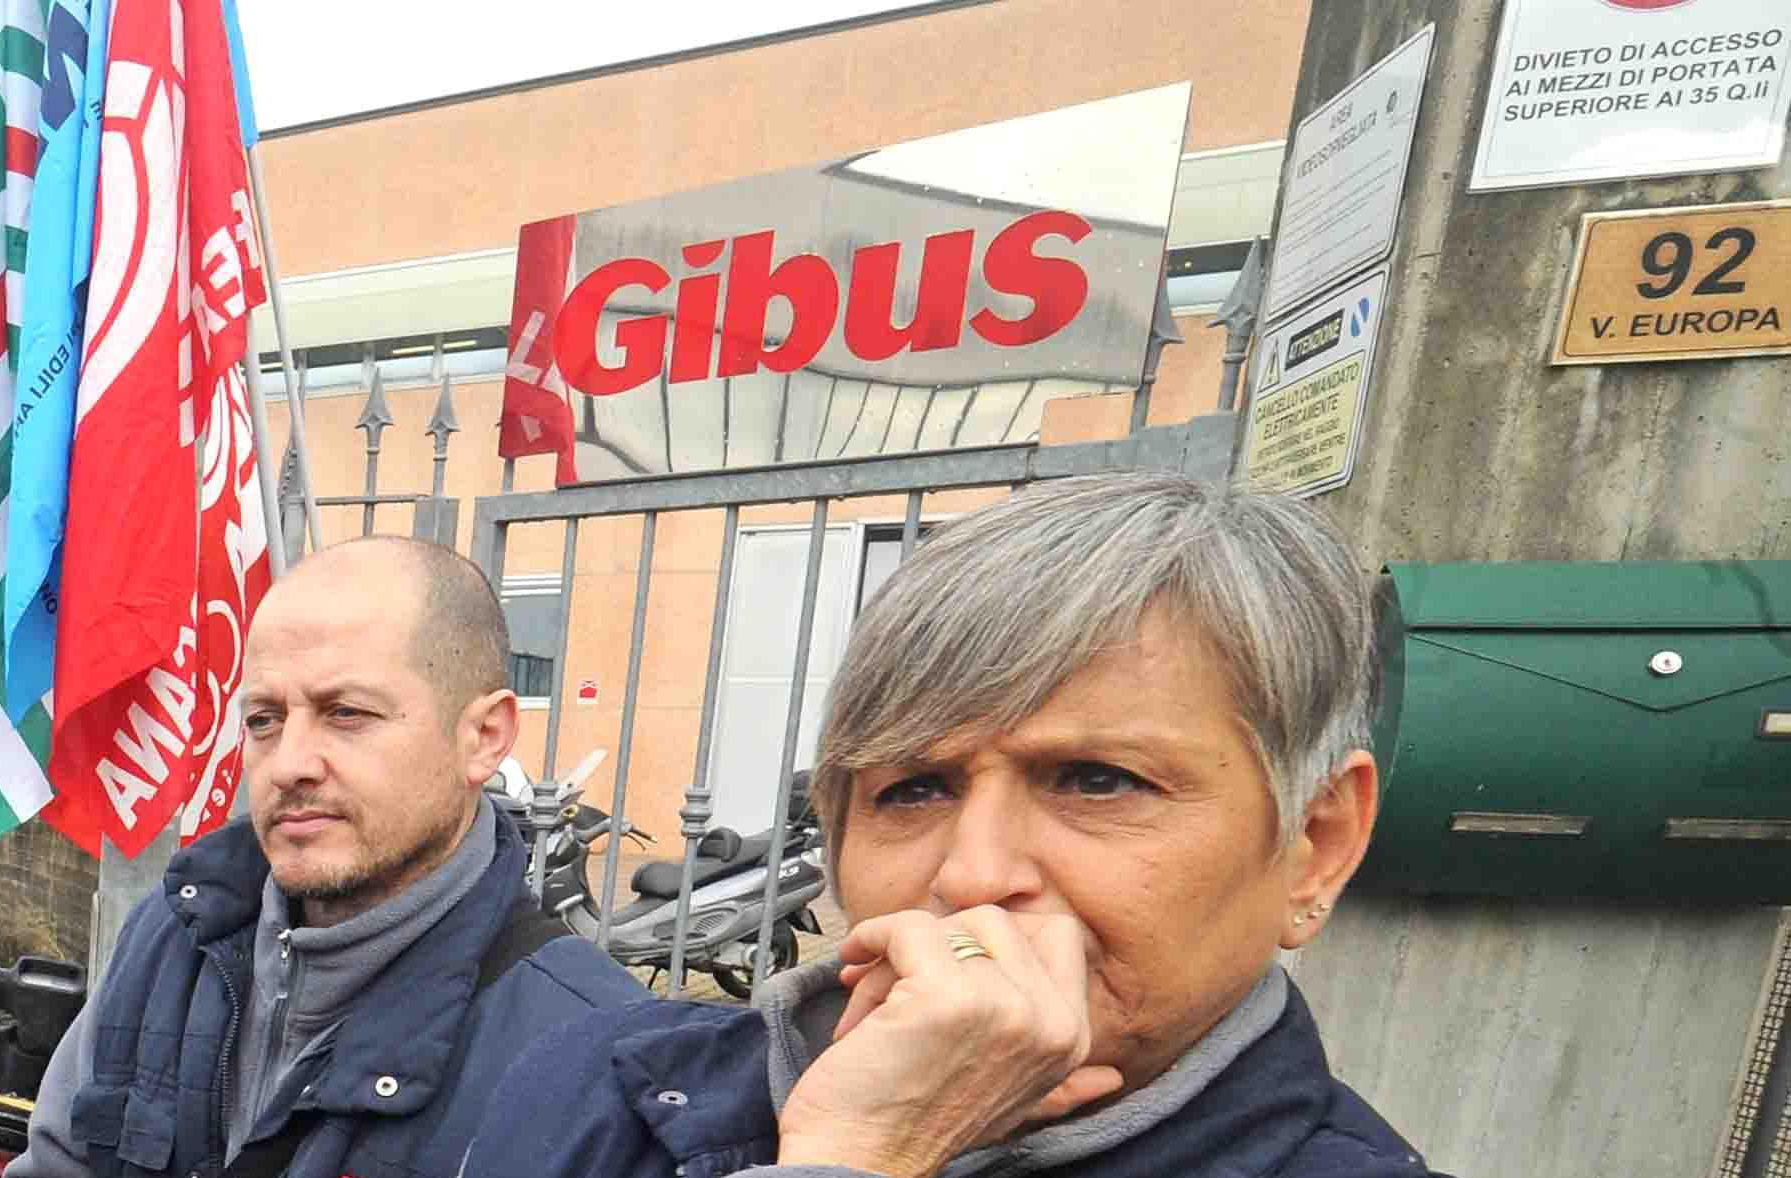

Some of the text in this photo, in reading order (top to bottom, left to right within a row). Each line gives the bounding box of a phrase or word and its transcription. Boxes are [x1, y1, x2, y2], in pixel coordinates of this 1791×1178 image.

[1513, 28, 1783, 72] DIVIETO DI ACCESSO
[1505, 55, 1778, 97] AI MEZZI DI PORTATA
[1504, 93, 1649, 122] SUPERIORE
[1655, 90, 1683, 108] AI
[1689, 85, 1720, 104] 35
[1635, 226, 1757, 300] 92
[553, 208, 1093, 397] Gibus
[1590, 306, 1781, 339] V. EUROPA
